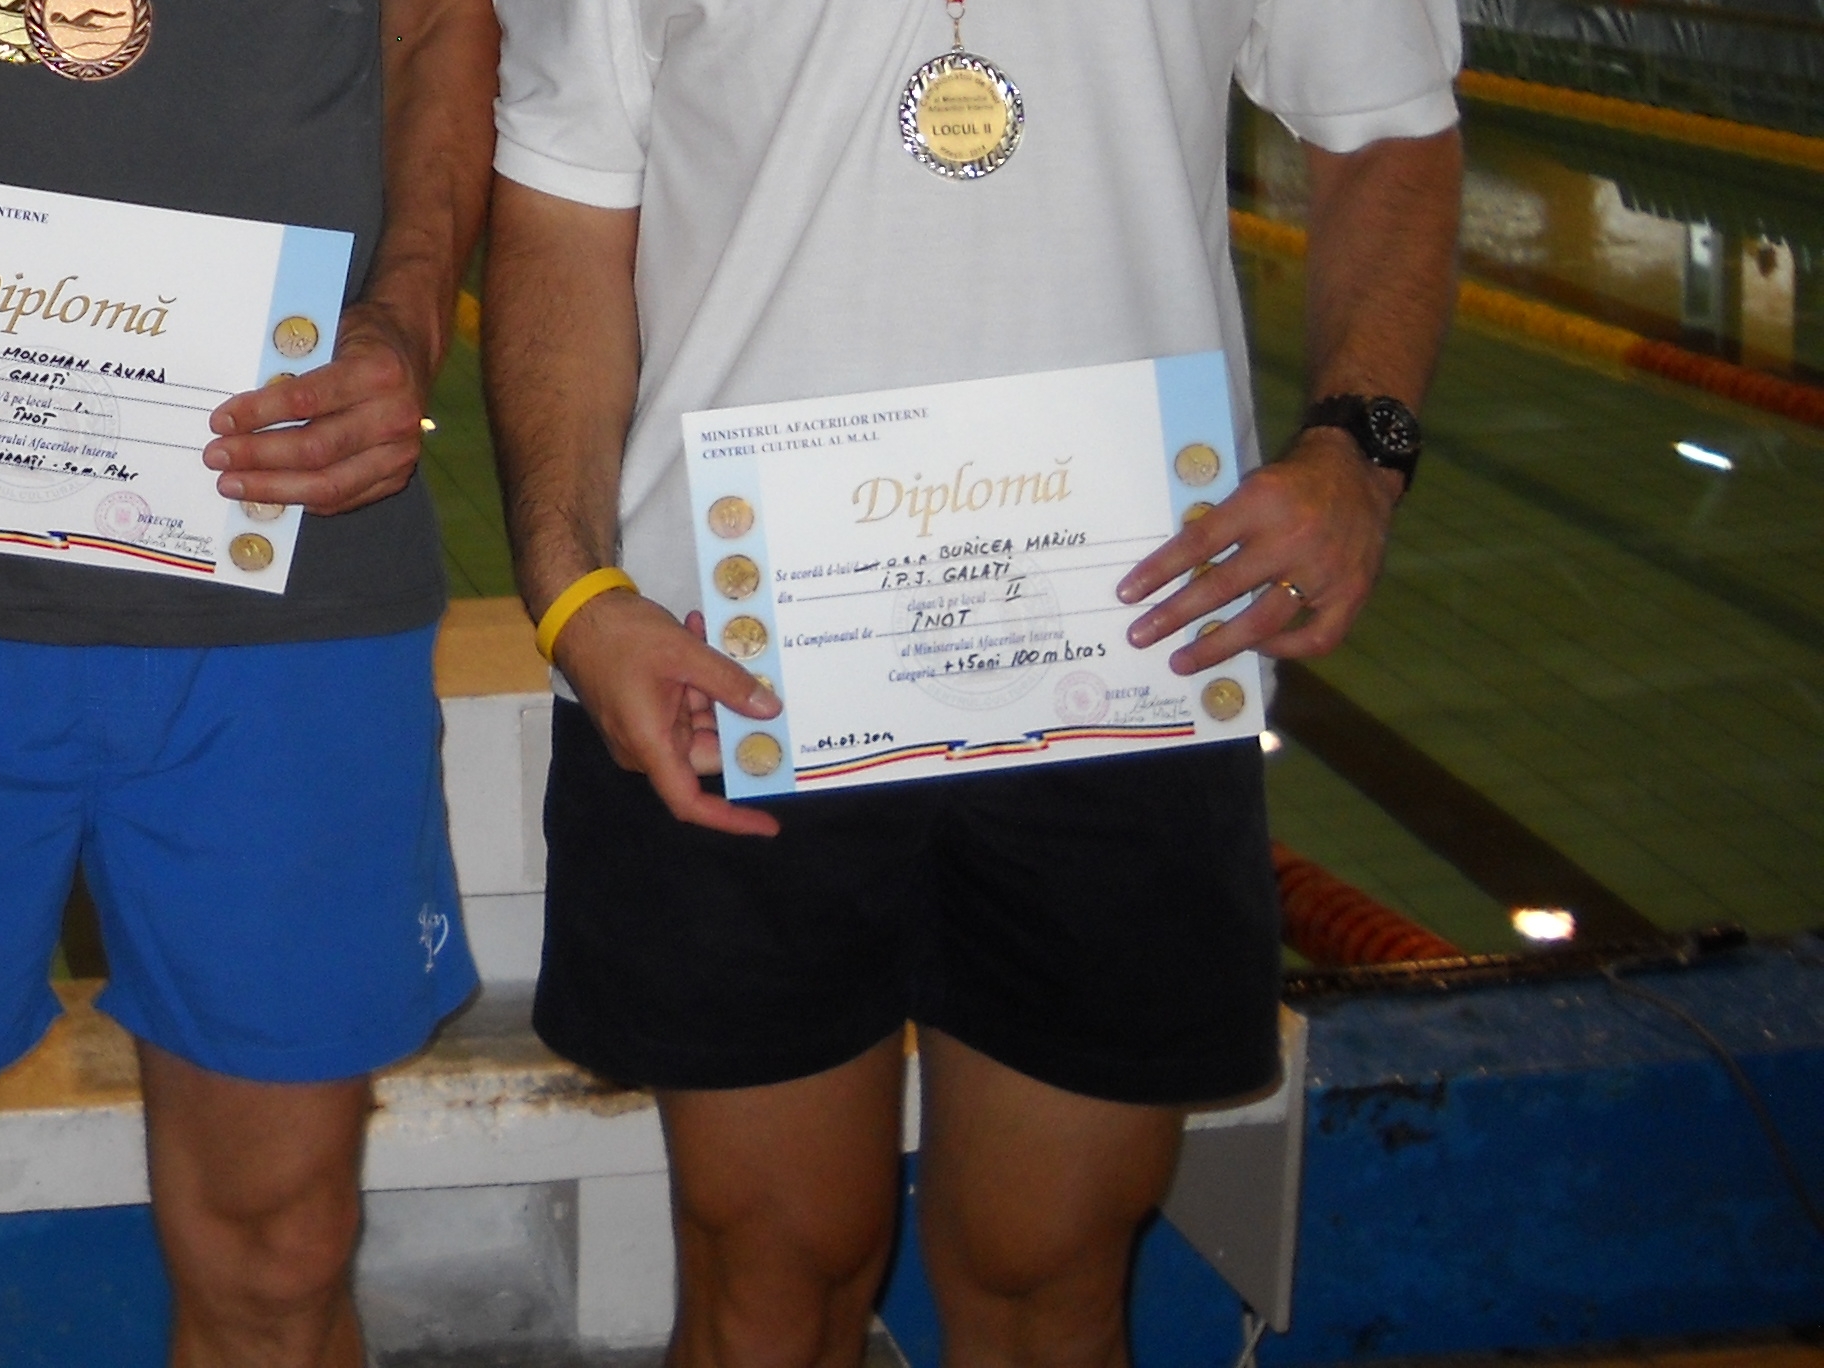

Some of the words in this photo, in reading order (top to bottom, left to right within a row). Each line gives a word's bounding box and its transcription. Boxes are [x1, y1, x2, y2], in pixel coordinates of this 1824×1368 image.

[933, 124, 979, 136] LOCUL
[983, 123, 992, 133] II
[3, 346, 89, 371] MOLOMAN
[99, 362, 165, 384] EDUARD
[11, 394, 24, 407] pe
[701, 424, 780, 442] MINISTERUL
[786, 414, 870, 433] AFACERILOR
[873, 407, 929, 424] INTERNE
[29, 437, 78, 454] Afacerilor
[81, 445, 118, 460] Interne
[702, 445, 757, 460] CENTRUL
[761, 437, 824, 454] CULTURAL
[828, 436, 843, 446] AL
[847, 431, 880, 443] M.A.I.
[852, 456, 1073, 538] Diplomă
[137, 513, 184, 528] DIRECTOR
[939, 536, 1014, 559] BURICEA
[1025, 529, 1087, 552] MARIUS
[776, 570, 787, 582] Se
[790, 564, 823, 580] acordă
[777, 592, 793, 604] din
[947, 597, 959, 610] pe
[784, 636, 793, 647] la
[797, 629, 858, 647] Campionatul
[862, 628, 873, 639] de
[901, 644, 910, 657] al
[914, 638, 974, 656] Ministerului
[977, 633, 1025, 650] Afacerilor
[1029, 630, 1065, 643] Interne
[1065, 640, 1106, 661] bras
[1105, 686, 1150, 700] DIRECTOR
